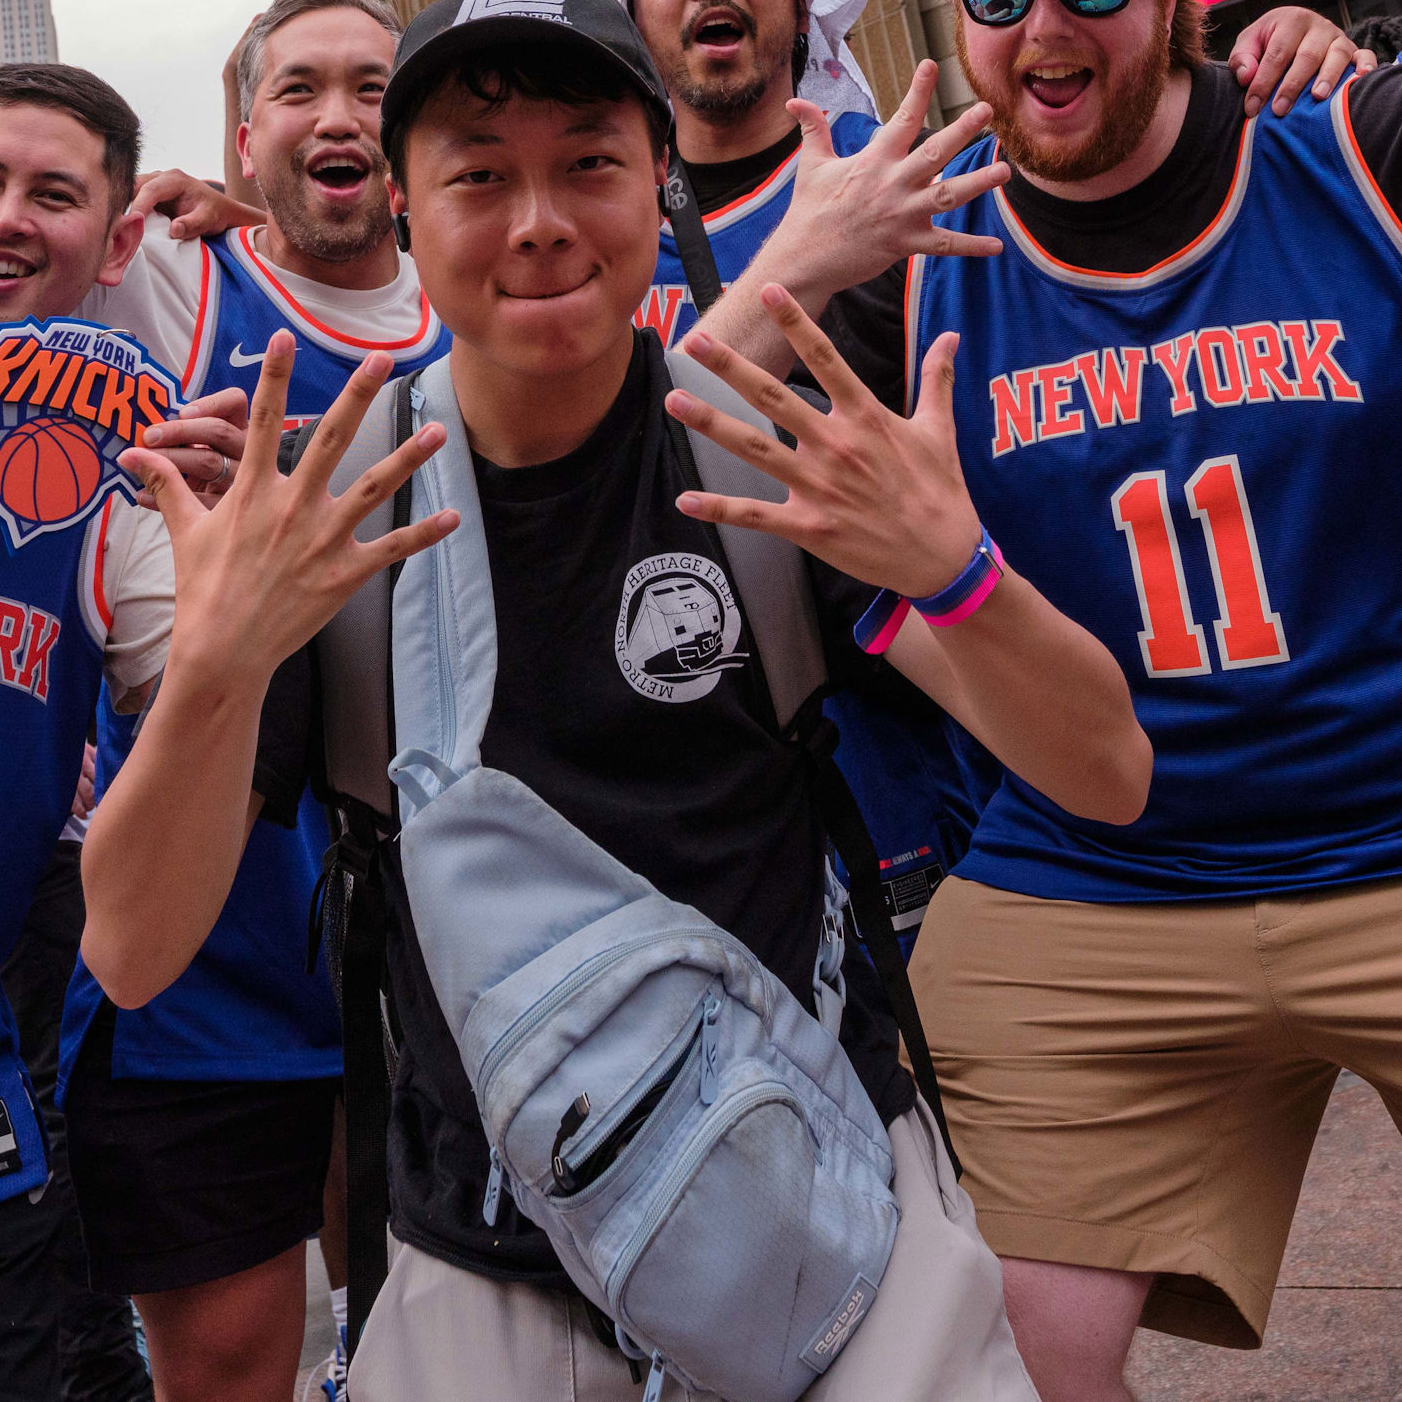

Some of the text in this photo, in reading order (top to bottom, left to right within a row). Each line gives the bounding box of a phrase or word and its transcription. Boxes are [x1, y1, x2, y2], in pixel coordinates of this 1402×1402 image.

[44, 330, 137, 374] NEW YORK
[989, 319, 1364, 458] NEW YORK
[628, 556, 736, 610] HERITAGE FLEET
[1110, 454, 1290, 678] 11
[617, 592, 674, 699] METRO-NORTH
[814, 1290, 864, 1355] Reebok
